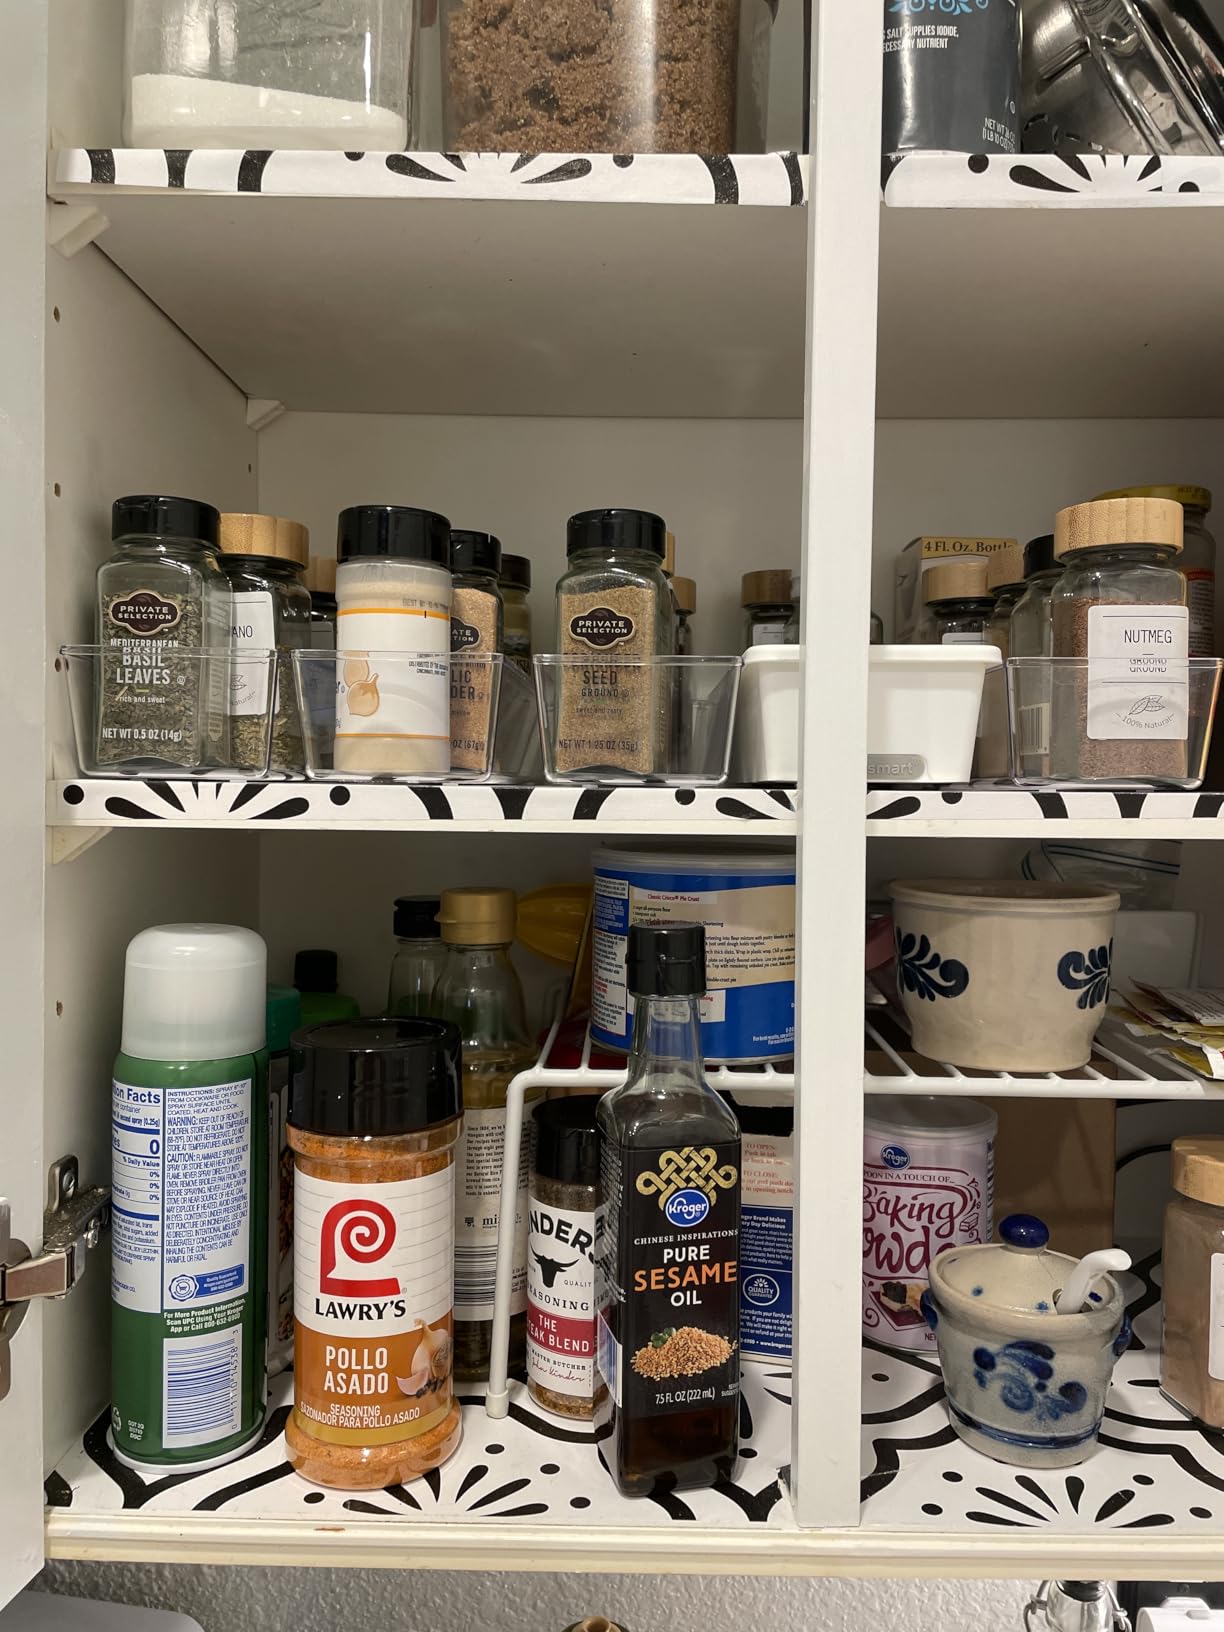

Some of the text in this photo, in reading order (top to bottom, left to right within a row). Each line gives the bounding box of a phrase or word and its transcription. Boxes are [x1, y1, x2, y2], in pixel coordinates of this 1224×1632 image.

[887, 26, 903, 40] SALT
[883, 38, 949, 52] ECESSARY NUTRIENT
[924, 541, 1013, 552] 4 Fl. Oz. Bottl
[111, 639, 179, 648] MEDITERRANEAN
[1124, 629, 1172, 644] NUTMEG
[123, 654, 165, 666] BASIL
[1129, 658, 1167, 673] GROUND
[116, 668, 171, 684] LEAVES
[583, 670, 617, 685] SEED
[582, 688, 619, 697] GROUND
[1122, 715, 1172, 729] 100% Natural
[102, 728, 182, 742] NET WT 0.5 OZ (14g)
[559, 740, 571, 748] NET
[575, 740, 586, 749] WT
[607, 741, 616, 750] OZ
[868, 762, 913, 774] smart
[127, 1088, 160, 1104] Facts
[186, 1093, 220, 1102] COOKWARE
[120, 1104, 141, 1113] container
[188, 1100, 214, 1108] SURFACE
[167, 1116, 198, 1126] WARNING:
[149, 1139, 160, 1155] 0
[127, 1157, 141, 1167] Daily
[167, 1153, 195, 1163] CAUTION:
[883, 1149, 907, 1165] Kroger
[863, 1171, 883, 1179] POON
[902, 1173, 935, 1182] TOUCH
[149, 1182, 159, 1190] 0%
[669, 1198, 707, 1219] Kroger
[863, 1184, 955, 1239] Baking
[634, 1229, 738, 1245] CHINESE INSPIRATIONS
[664, 1245, 710, 1263] PURE
[634, 1261, 737, 1291] SESAME
[748, 1286, 774, 1294] QUALITY
[528, 1286, 589, 1311] EASONING
[671, 1290, 702, 1307] OIL
[191, 1308, 214, 1316] Product
[196, 1315, 212, 1323] Using
[213, 1311, 226, 1319] Your
[227, 1306, 244, 1316] Kroger
[315, 1298, 407, 1321] LAWRY'S
[539, 1314, 557, 1332] THE
[528, 1320, 589, 1352] TEAK BLEND
[325, 1345, 388, 1370] POLLO
[532, 1349, 586, 1370] MASTER BUTCHER
[323, 1370, 389, 1395] ASADO
[665, 1393, 674, 1403] FL
[675, 1391, 686, 1402] OZ
[687, 1389, 701, 1402] (222
[702, 1387, 715, 1400] mL)
[300, 1401, 420, 1428] SAZONADOR PARA POLLO ASADO
[330, 1403, 380, 1417] SEASONING
